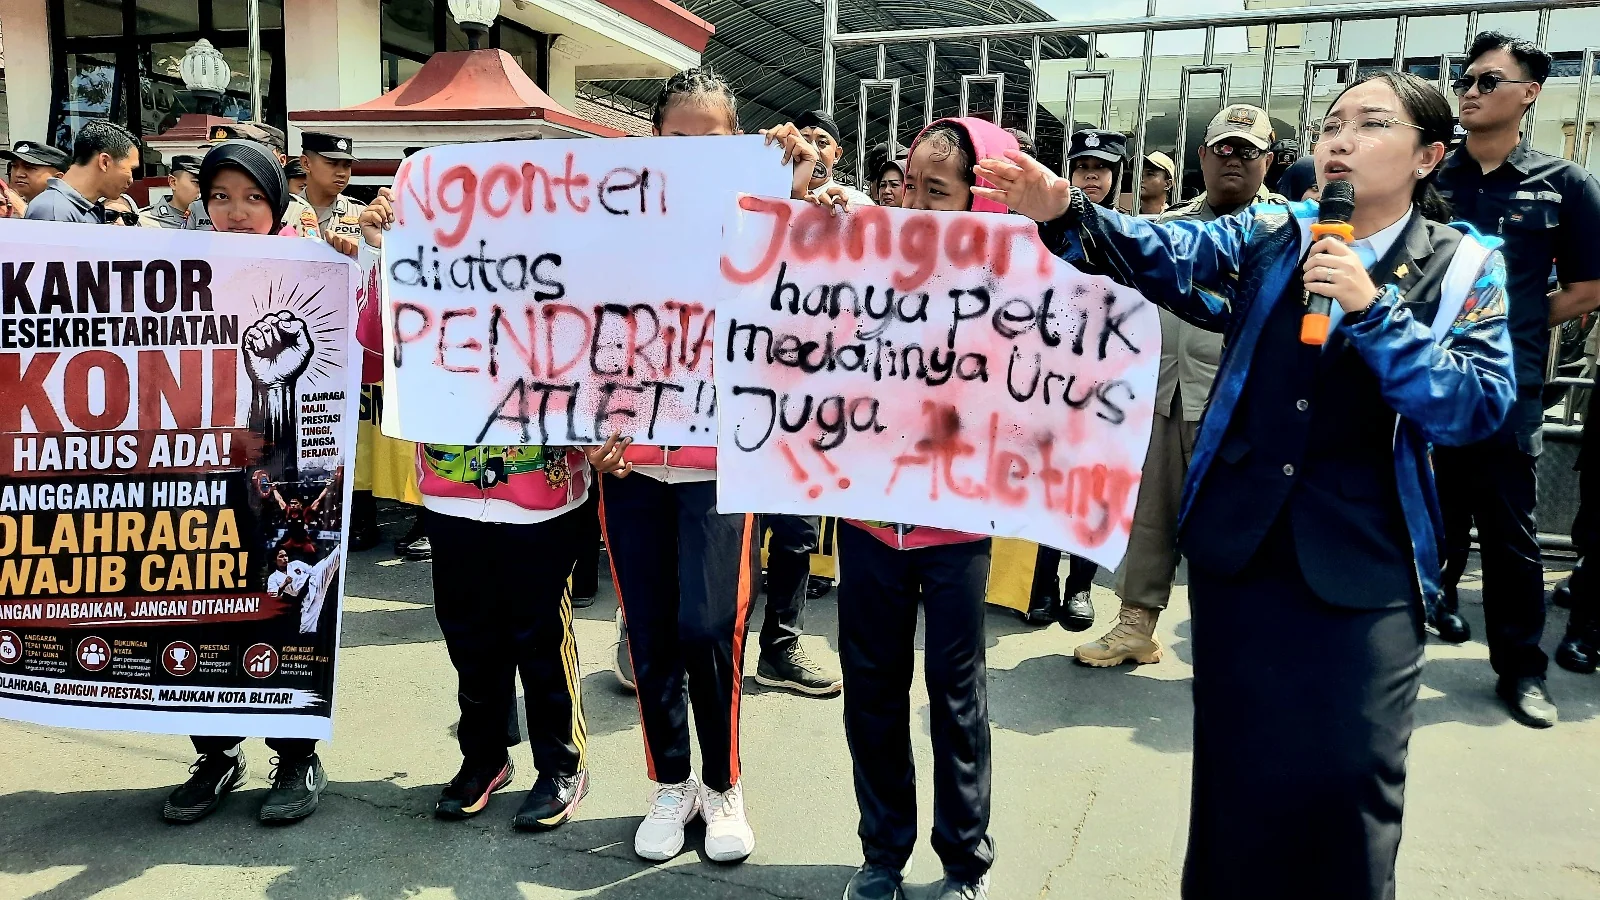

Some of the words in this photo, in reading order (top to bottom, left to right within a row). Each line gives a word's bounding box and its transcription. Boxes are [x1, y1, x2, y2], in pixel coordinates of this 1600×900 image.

[391, 151, 668, 248] Ngonten
[335, 226, 361, 234] POLR
[389, 239, 566, 301] diatas
[2, 260, 214, 315] KANTOR
[770, 262, 930, 339] hanya
[0, 315, 238, 349] ESEKRETARIATAN
[726, 318, 989, 387] medalinya
[0, 350, 238, 432] KONI
[301, 391, 345, 402] OLAHRAGA
[301, 404, 328, 413] MAJU,
[301, 414, 341, 425] PRESTASI
[301, 426, 332, 436] TINGGI,
[301, 437, 335, 447] BANGSA
[13, 432, 139, 472] HARUS
[148, 432, 232, 469] ADA!
[301, 447, 339, 458] BERJAYA!
[0, 482, 145, 511] ANGGARAN
[153, 481, 227, 508] HIBAH
[140, 552, 249, 592] CAIR!
[46, 601, 127, 619] DIABAIKAN,
[131, 600, 189, 617] JANGAN
[191, 598, 260, 616] DITAHAN!
[54, 682, 99, 698] BANGUN
[100, 685, 155, 702] PRESTASI,
[158, 689, 215, 703] MAJUKAN
[217, 691, 246, 704] KOTA
[249, 691, 293, 705] BLITAR!
